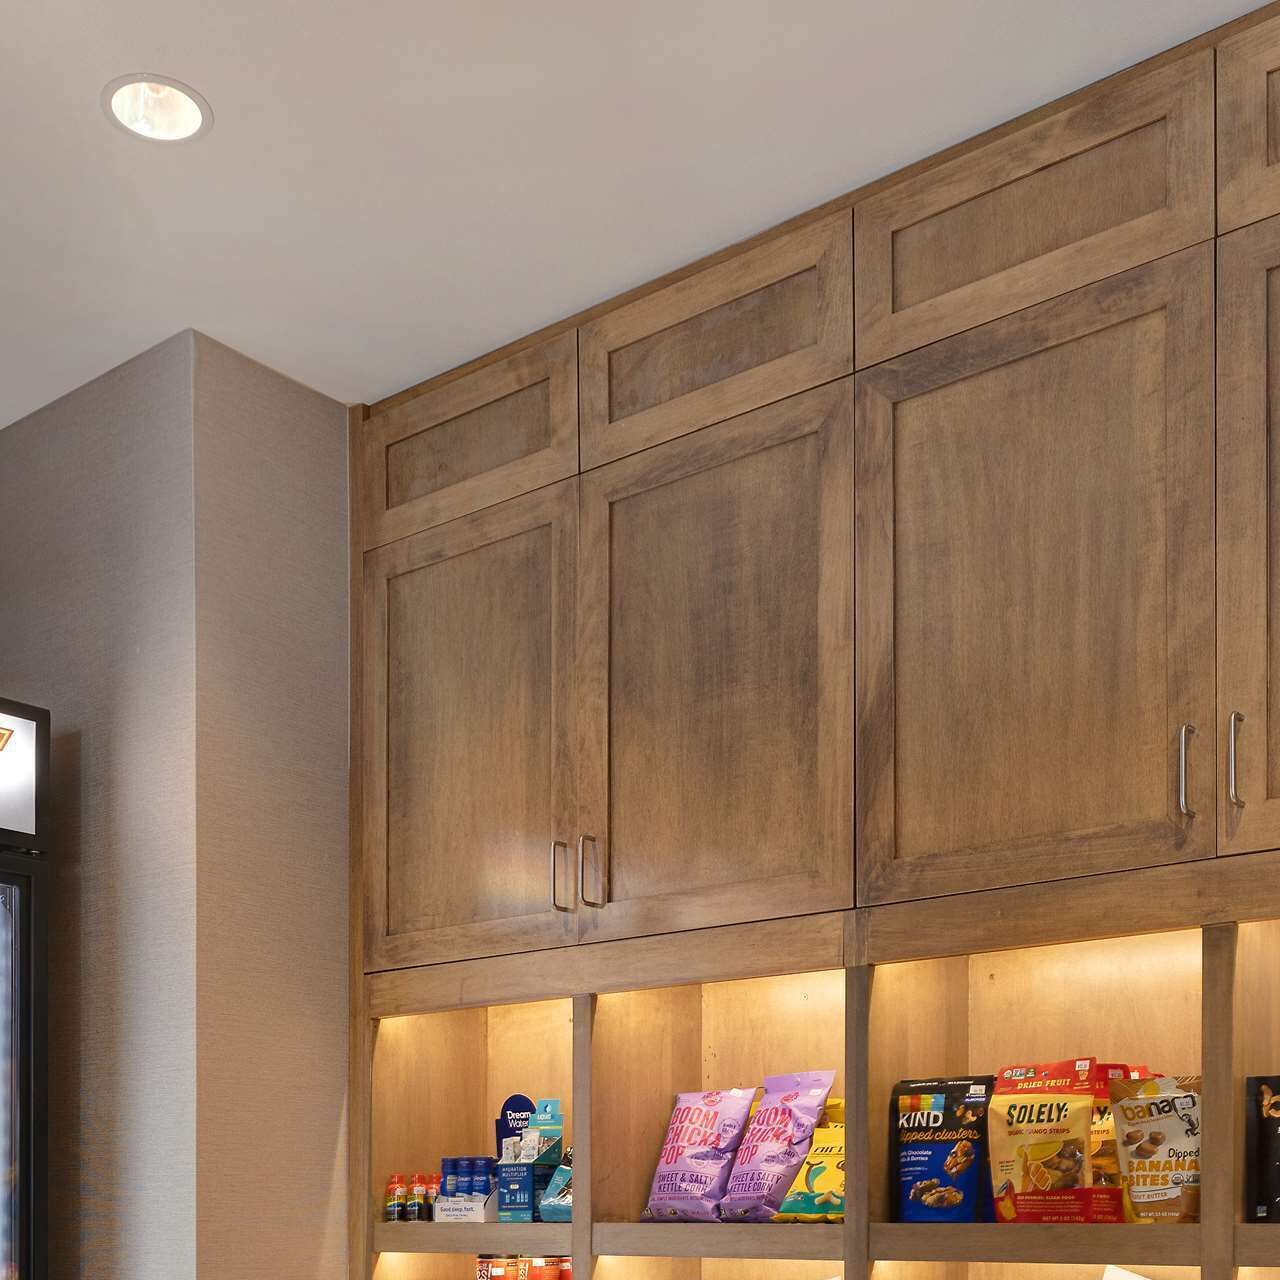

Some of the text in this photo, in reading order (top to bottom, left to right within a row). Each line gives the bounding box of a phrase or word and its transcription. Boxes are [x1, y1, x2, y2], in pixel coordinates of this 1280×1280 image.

[1017, 1079, 1072, 1090] DRIED FRUIT
[506, 1111, 531, 1119] Dream
[671, 1106, 719, 1128] BOOM
[750, 1106, 793, 1127] BOOM
[899, 1111, 944, 1128] KIND
[508, 1120, 528, 1128] Water
[665, 1125, 721, 1147] CHICKA
[935, 1127, 981, 1140] clusters
[660, 1145, 686, 1166] POP
[737, 1145, 757, 1166] POP
[1168, 1148, 1200, 1161] Dipped
[1128, 1160, 1200, 1172] BANANA
[658, 1172, 714, 1185] SWEET & SALTY
[730, 1171, 782, 1184] SWEET SALTY
[658, 1182, 708, 1193] KETTLE CORN
[729, 1181, 773, 1193] KETTLE CORN
